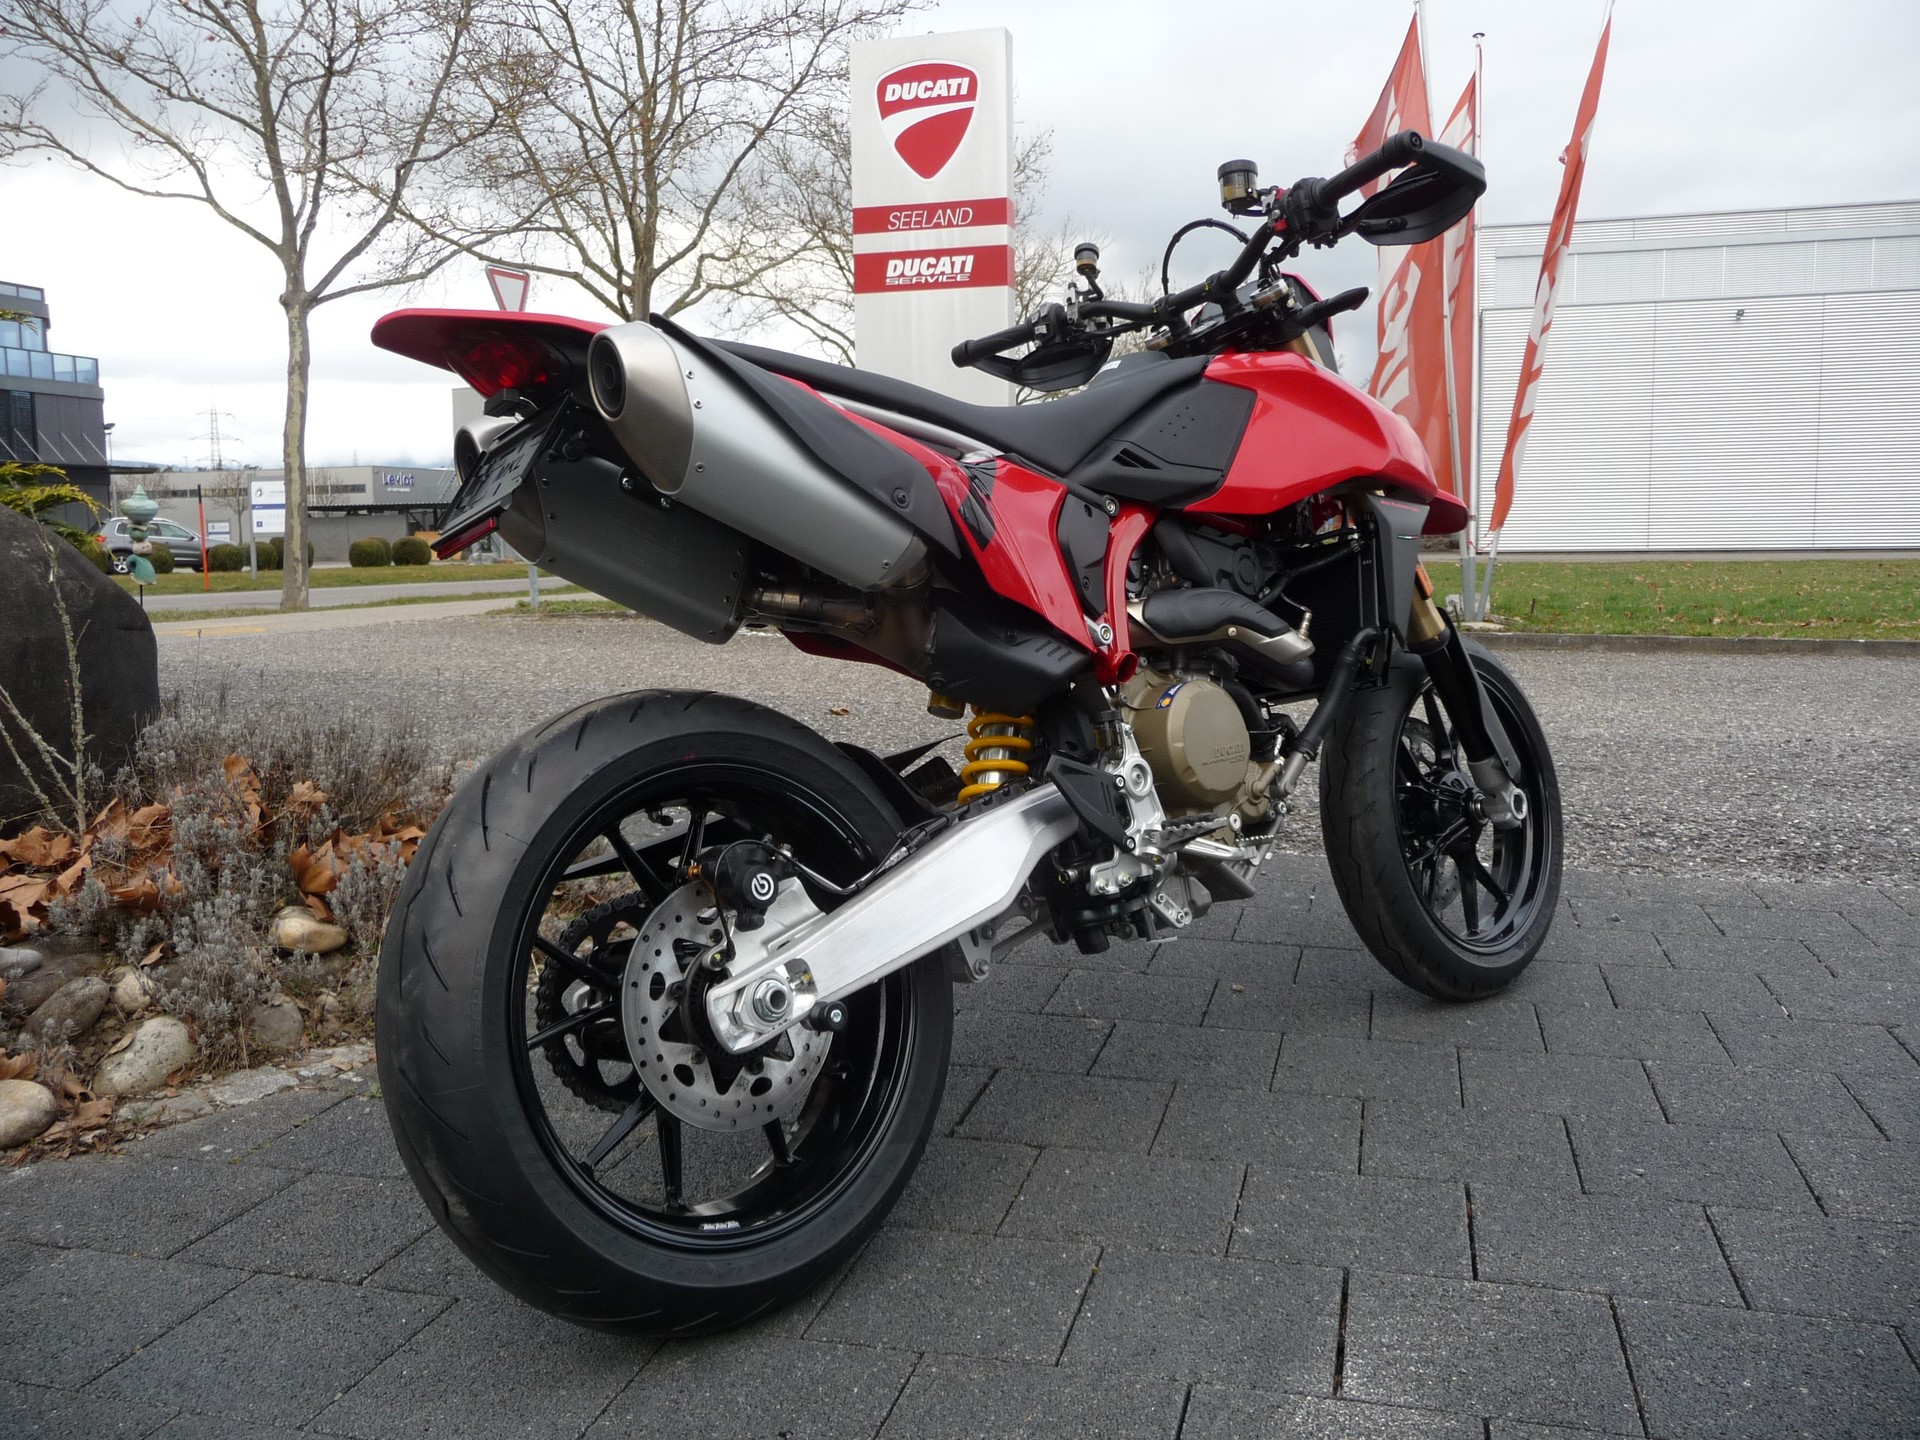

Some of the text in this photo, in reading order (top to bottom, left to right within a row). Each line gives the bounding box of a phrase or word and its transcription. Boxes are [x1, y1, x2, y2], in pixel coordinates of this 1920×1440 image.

[884, 77, 970, 102] DUCATI
[887, 207, 974, 231] SEELAND
[885, 255, 975, 278] DUCATI
[885, 273, 971, 286] SERVICE
